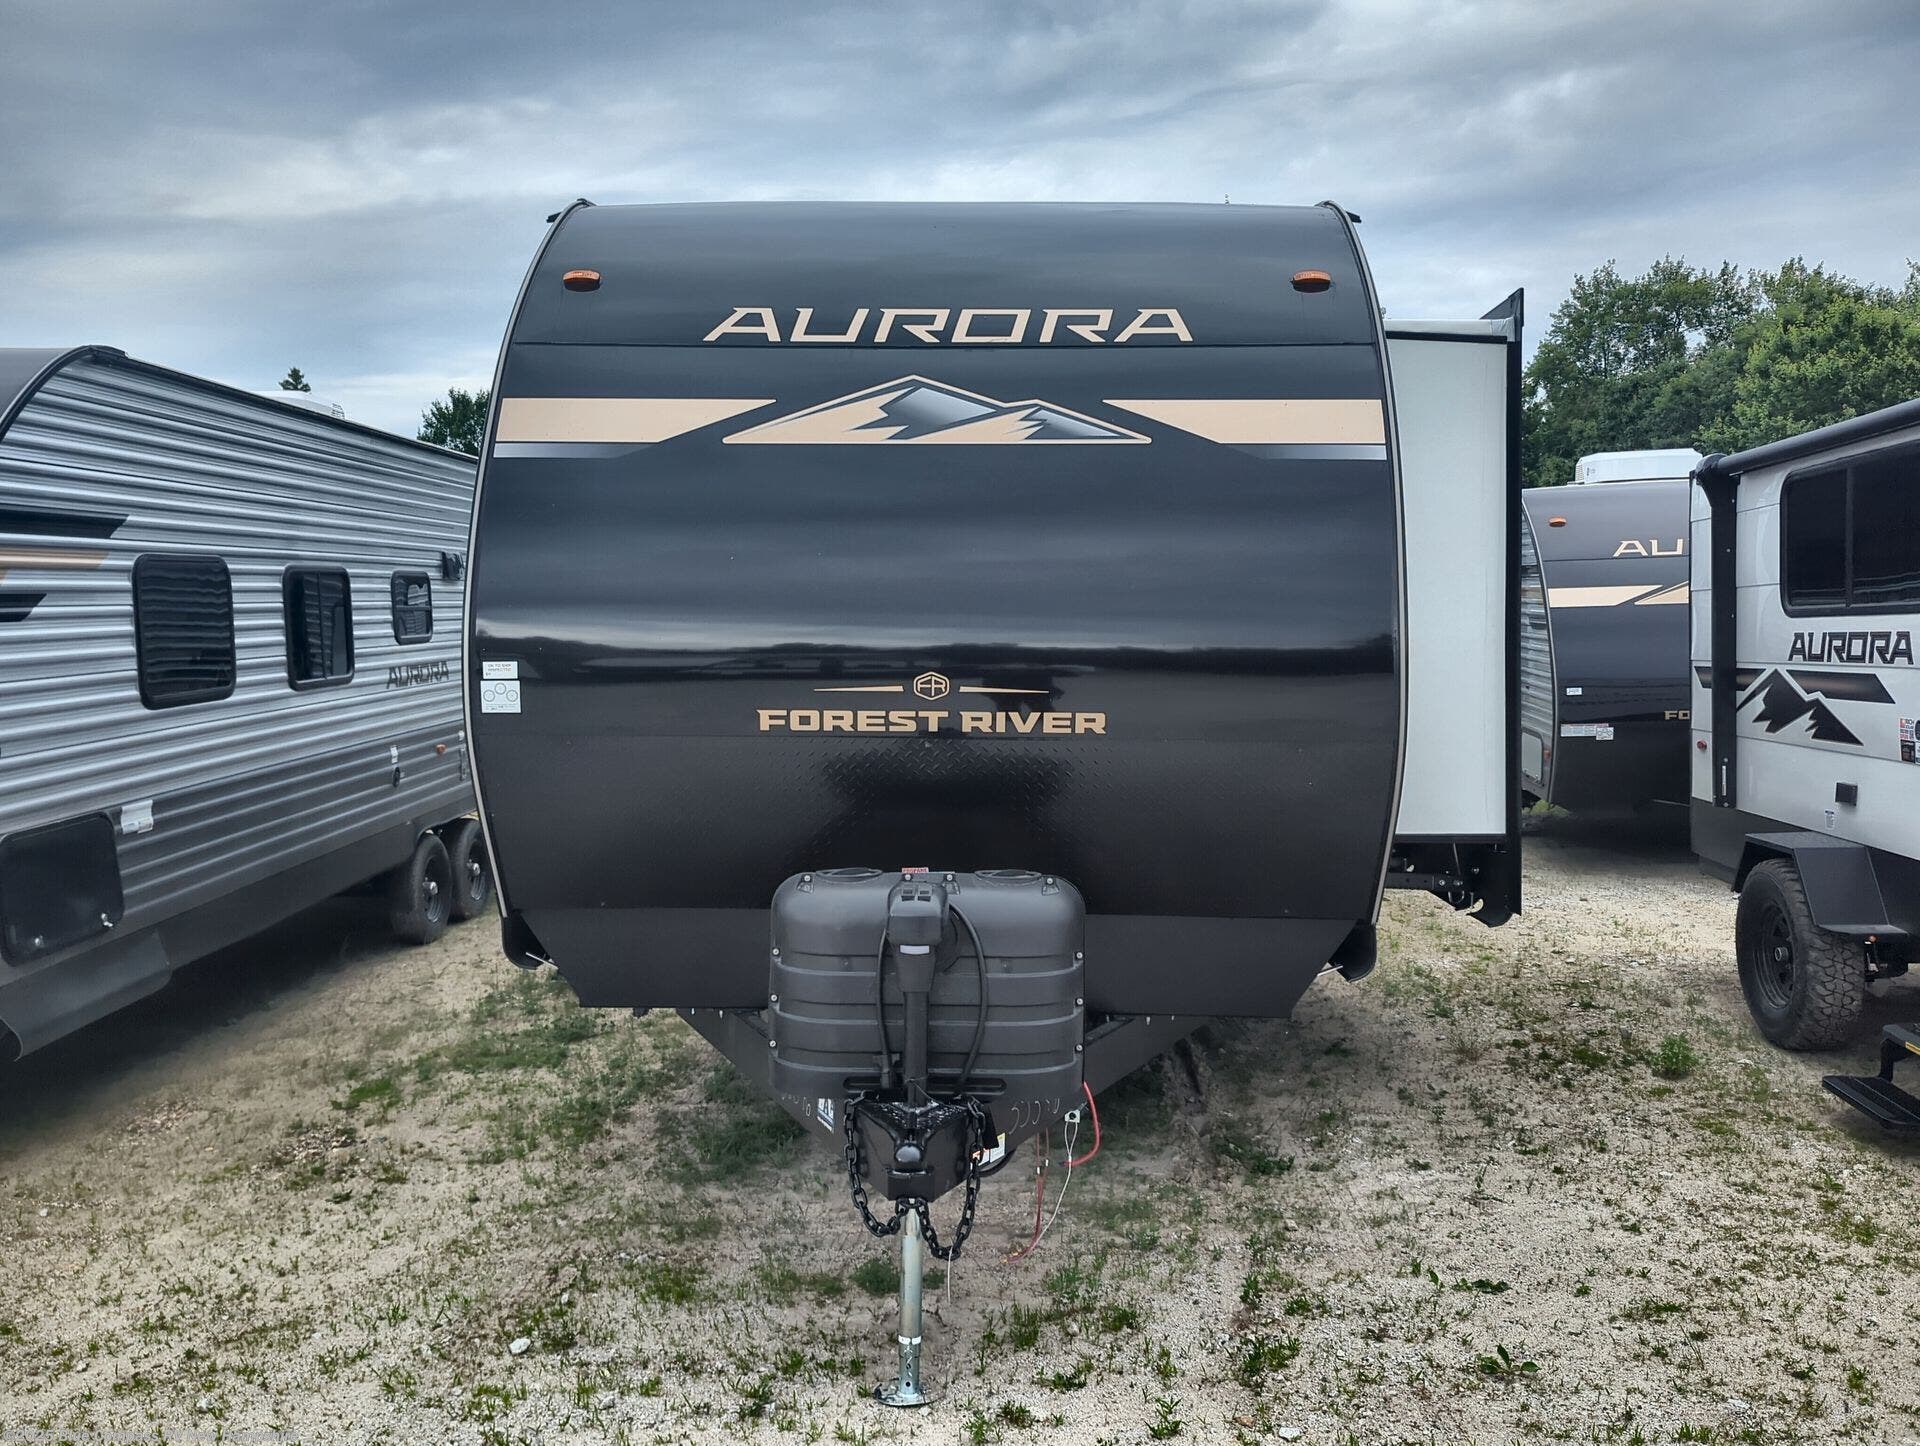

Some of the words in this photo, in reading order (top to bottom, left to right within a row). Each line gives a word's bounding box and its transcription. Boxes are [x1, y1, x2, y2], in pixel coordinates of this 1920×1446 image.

[703, 307, 1194, 343] AURORA
[1788, 631, 1914, 665] AURORA
[386, 661, 450, 689] AURORA
[757, 709, 949, 733] FOREST
[959, 711, 1107, 735] RIVER
